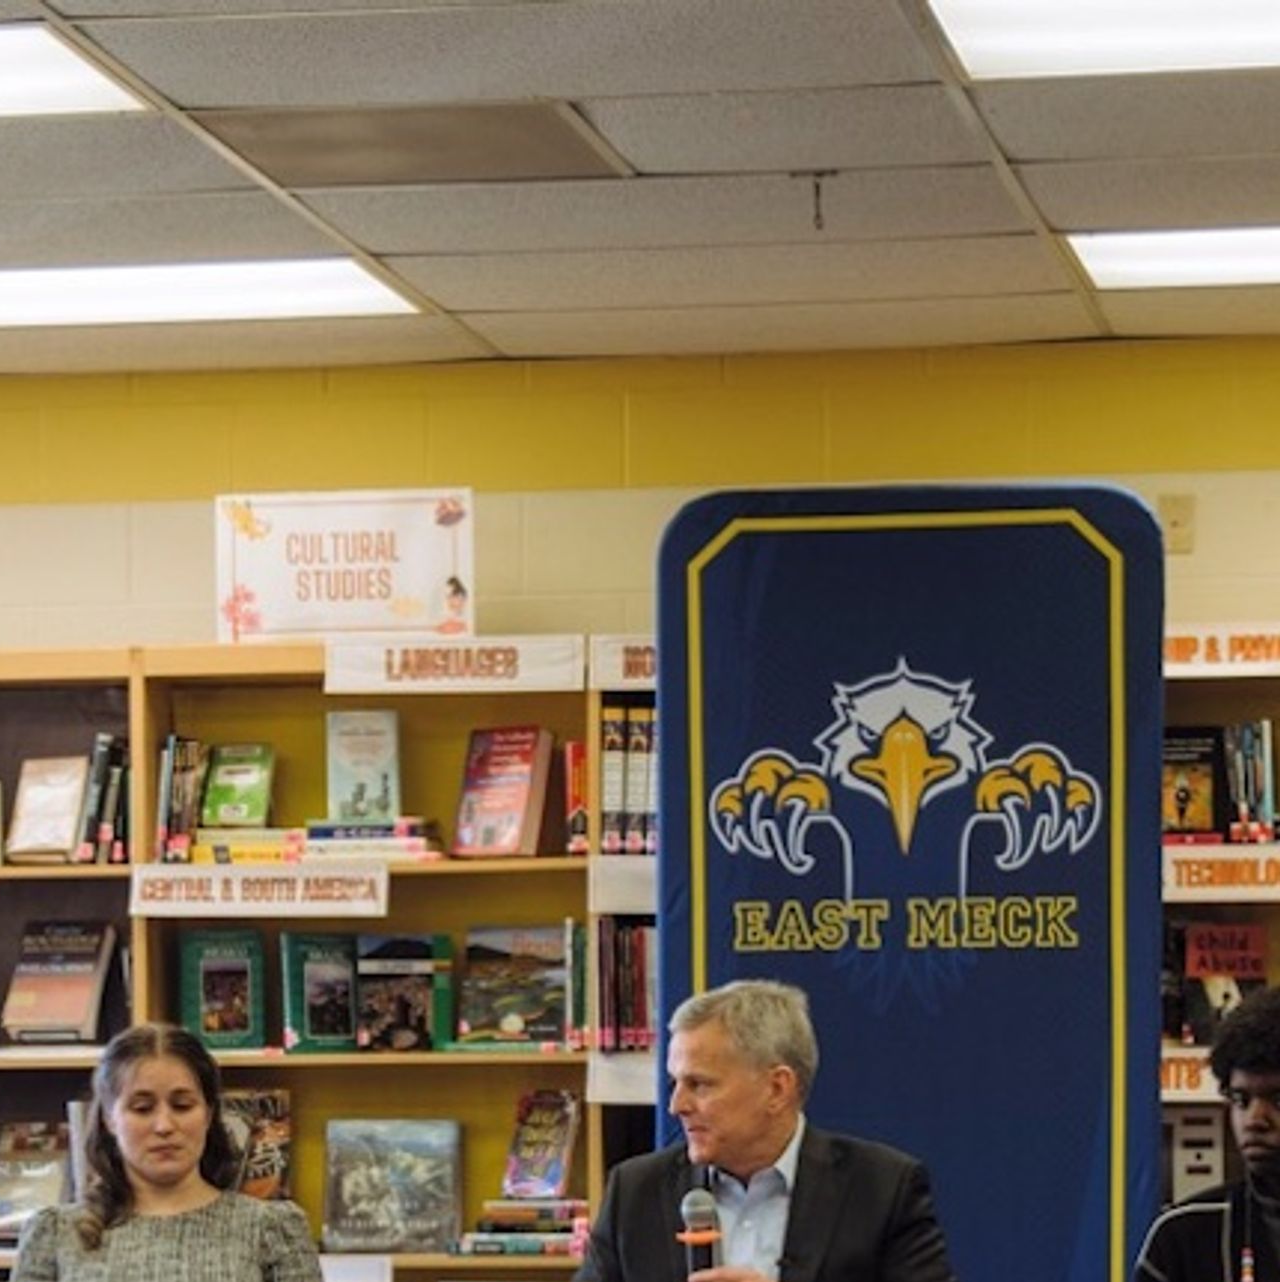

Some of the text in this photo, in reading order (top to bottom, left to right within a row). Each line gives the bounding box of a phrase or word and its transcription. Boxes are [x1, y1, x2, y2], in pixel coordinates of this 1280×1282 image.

[286, 531, 400, 565] CULTURAL
[297, 568, 392, 602] STUDIES
[385, 646, 519, 682] LANGUAGES
[140, 877, 215, 903] CENTRAL
[241, 876, 297, 902] SOUTH
[300, 876, 378, 901] AMERICA
[733, 897, 1080, 951] EAST MECK
